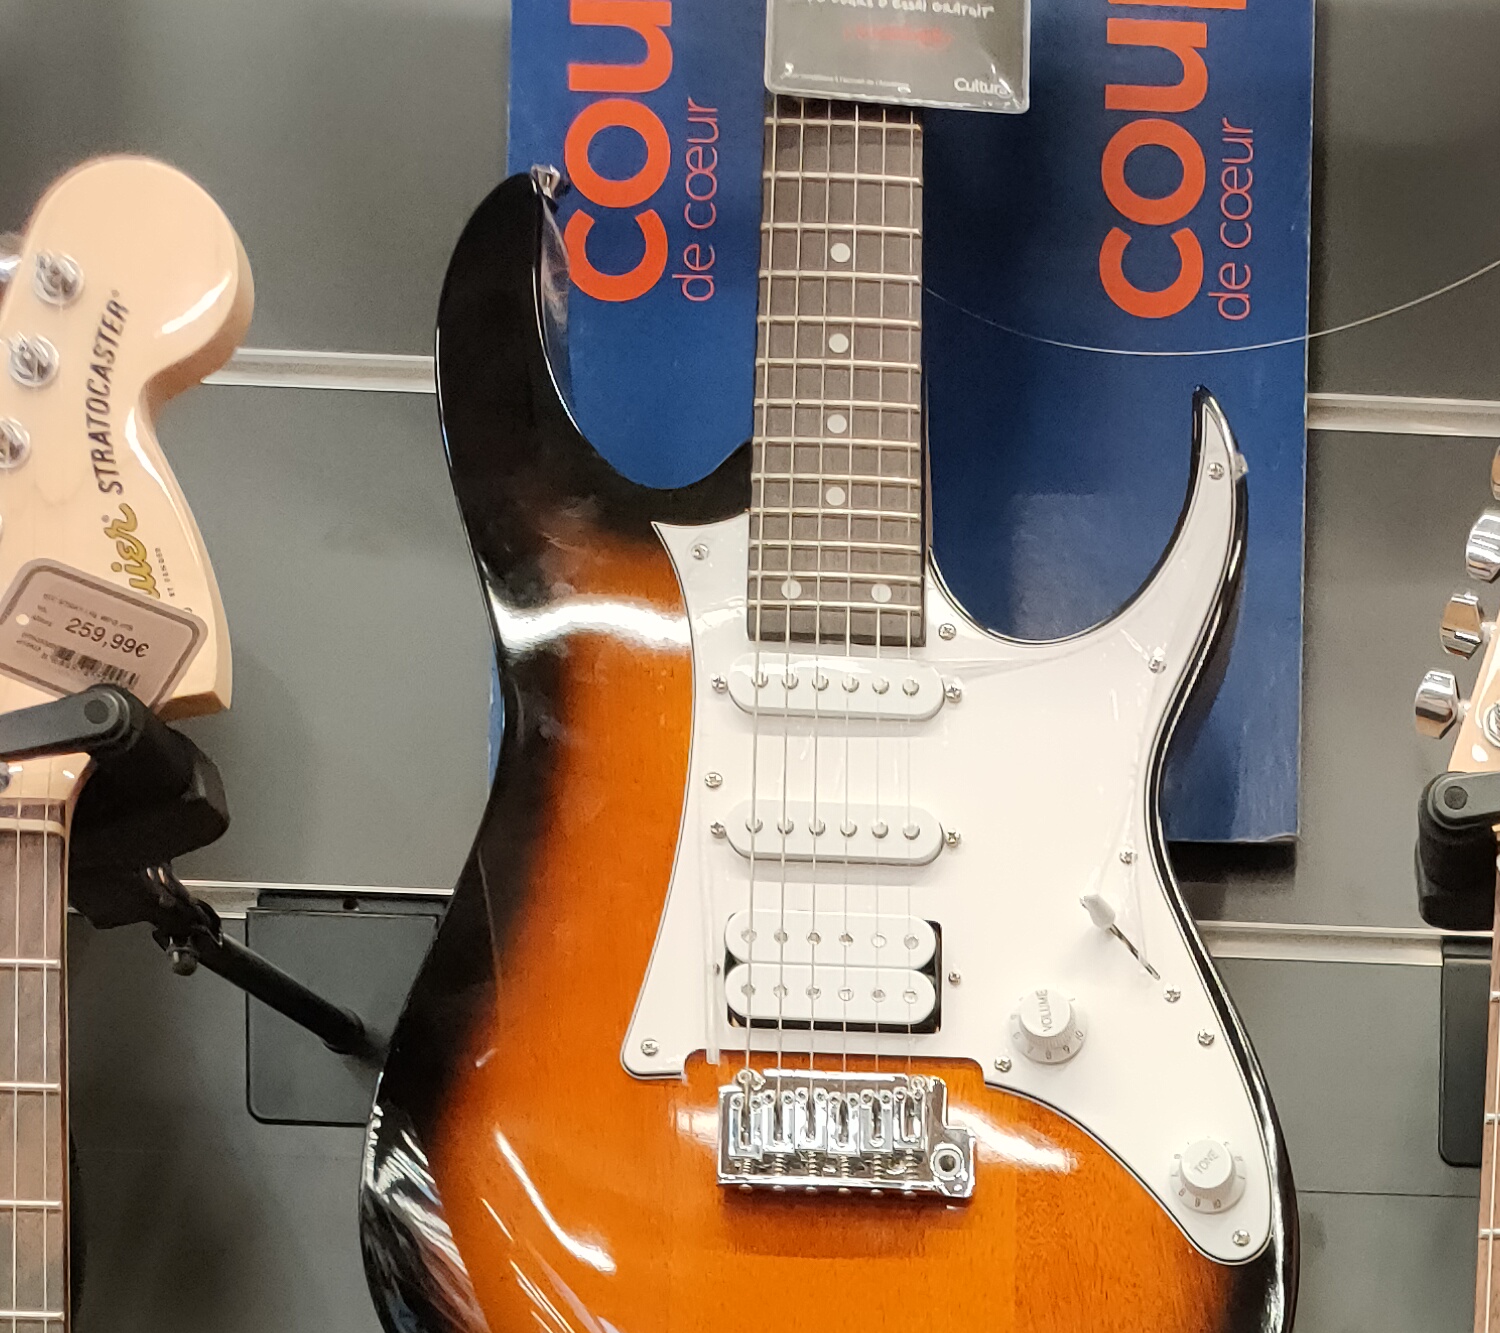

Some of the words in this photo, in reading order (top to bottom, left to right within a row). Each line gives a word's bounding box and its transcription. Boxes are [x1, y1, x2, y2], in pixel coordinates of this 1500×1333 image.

[684, 96, 719, 229] cœur
[1099, 0, 1247, 318] cou
[1220, 117, 1253, 249] cœur
[672, 243, 715, 302] de
[1208, 262, 1251, 321] de
[86, 297, 129, 495] STRATOCASTER
[65, 617, 149, 657] 259,99€
